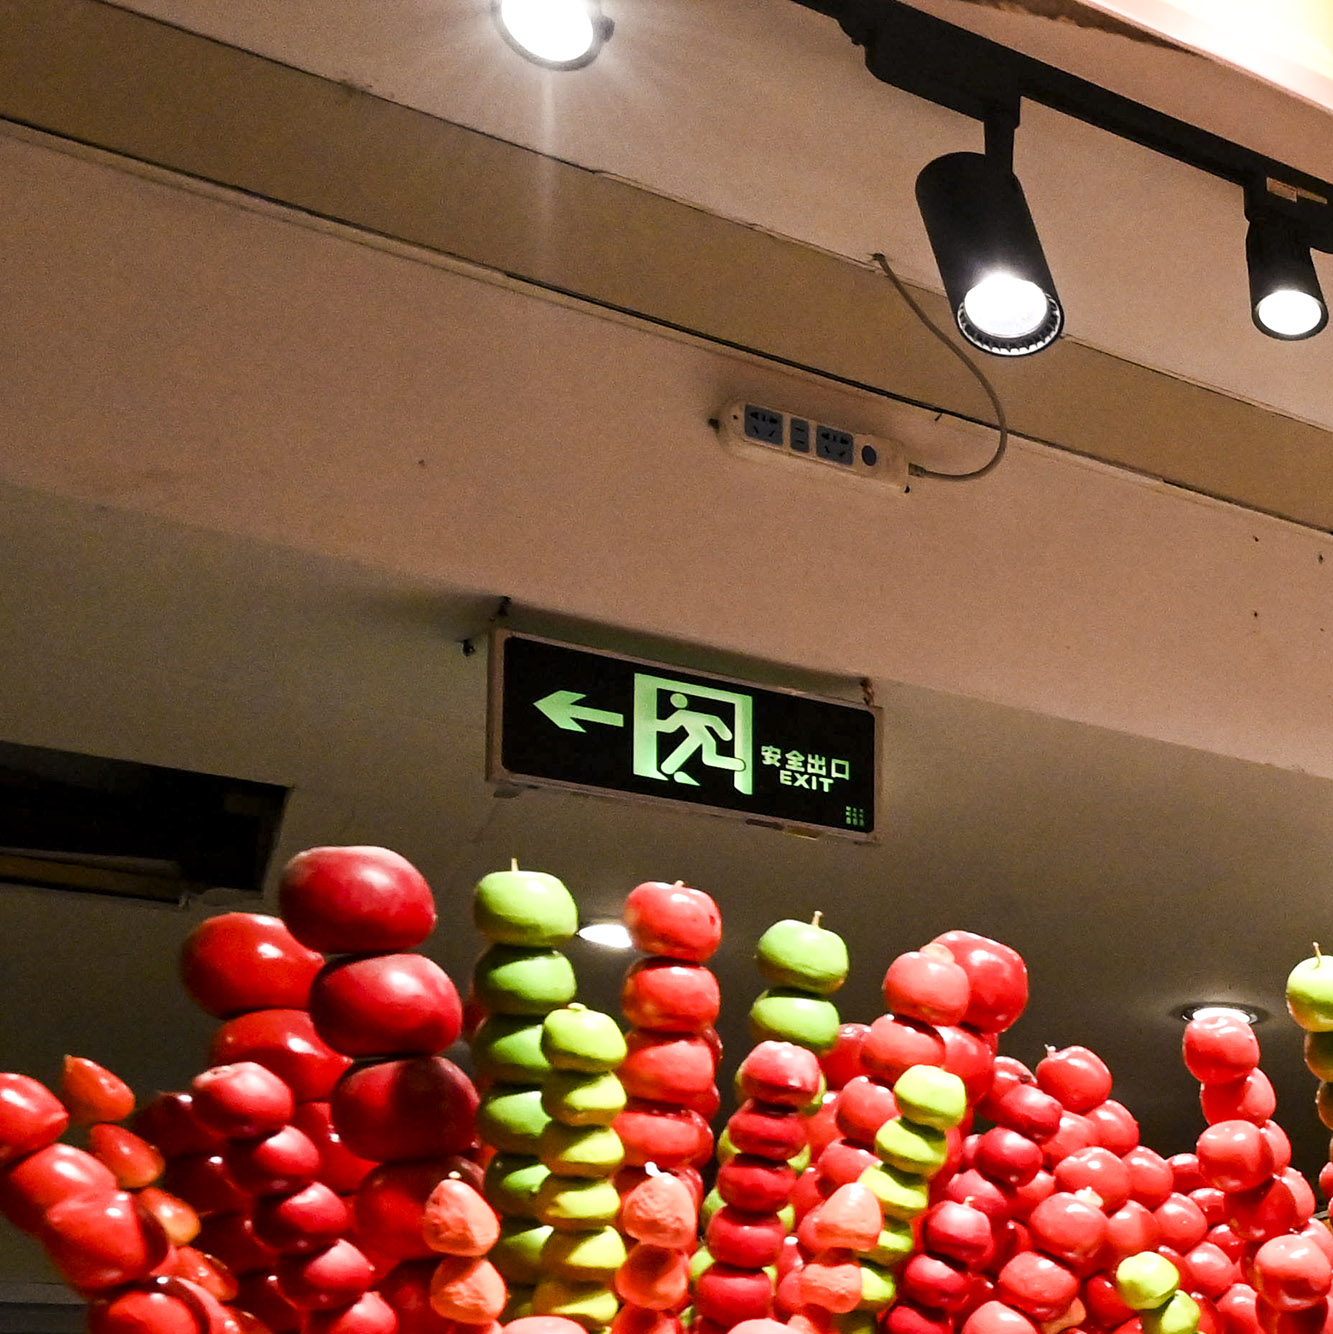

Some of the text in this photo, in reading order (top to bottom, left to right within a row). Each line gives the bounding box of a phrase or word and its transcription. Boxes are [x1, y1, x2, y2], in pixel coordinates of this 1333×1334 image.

[761, 745, 850, 781] 安全出口
[779, 769, 835, 793] EXIT
